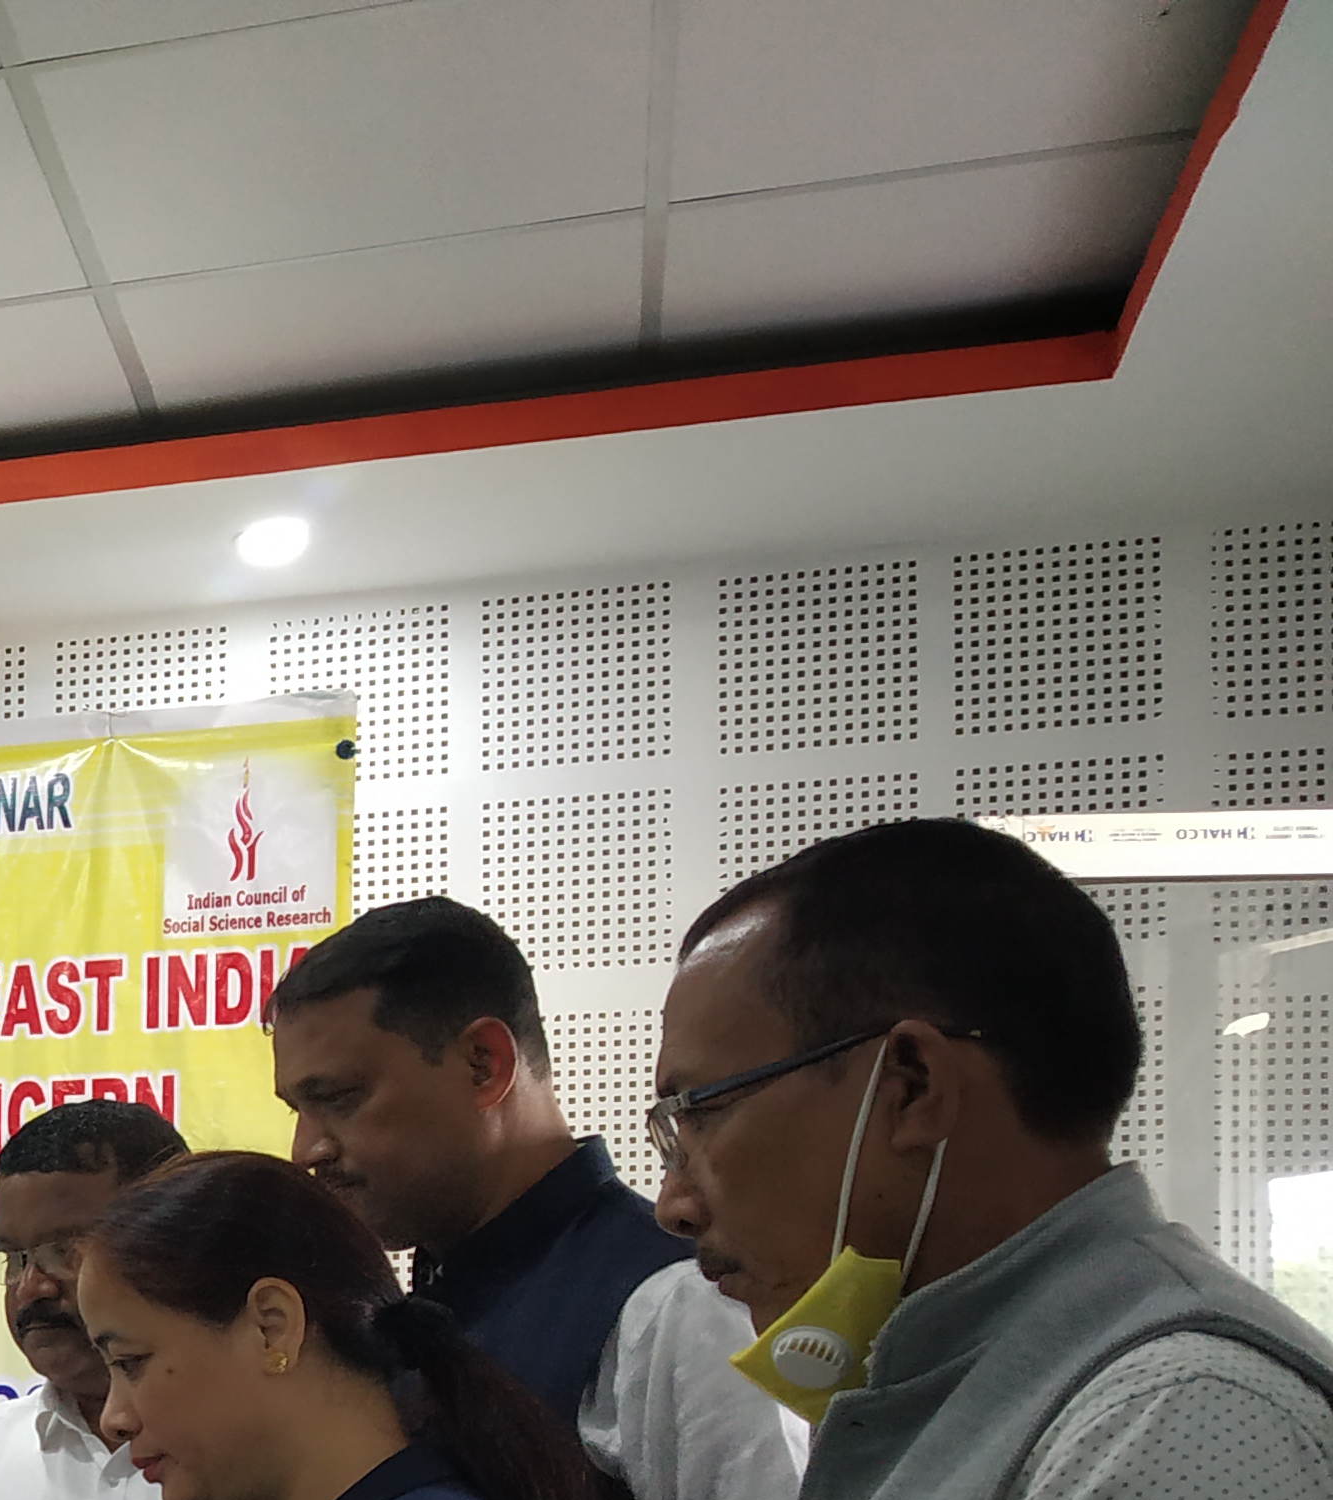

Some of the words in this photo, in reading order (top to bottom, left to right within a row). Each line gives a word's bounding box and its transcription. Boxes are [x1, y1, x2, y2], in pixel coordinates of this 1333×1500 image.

[187, 891, 231, 910] Indian
[236, 886, 288, 907] Council
[292, 885, 306, 902] of
[163, 916, 205, 934] Social
[209, 914, 262, 931] Science
[267, 907, 331, 927] Research
[146, 947, 309, 1030] INDI
